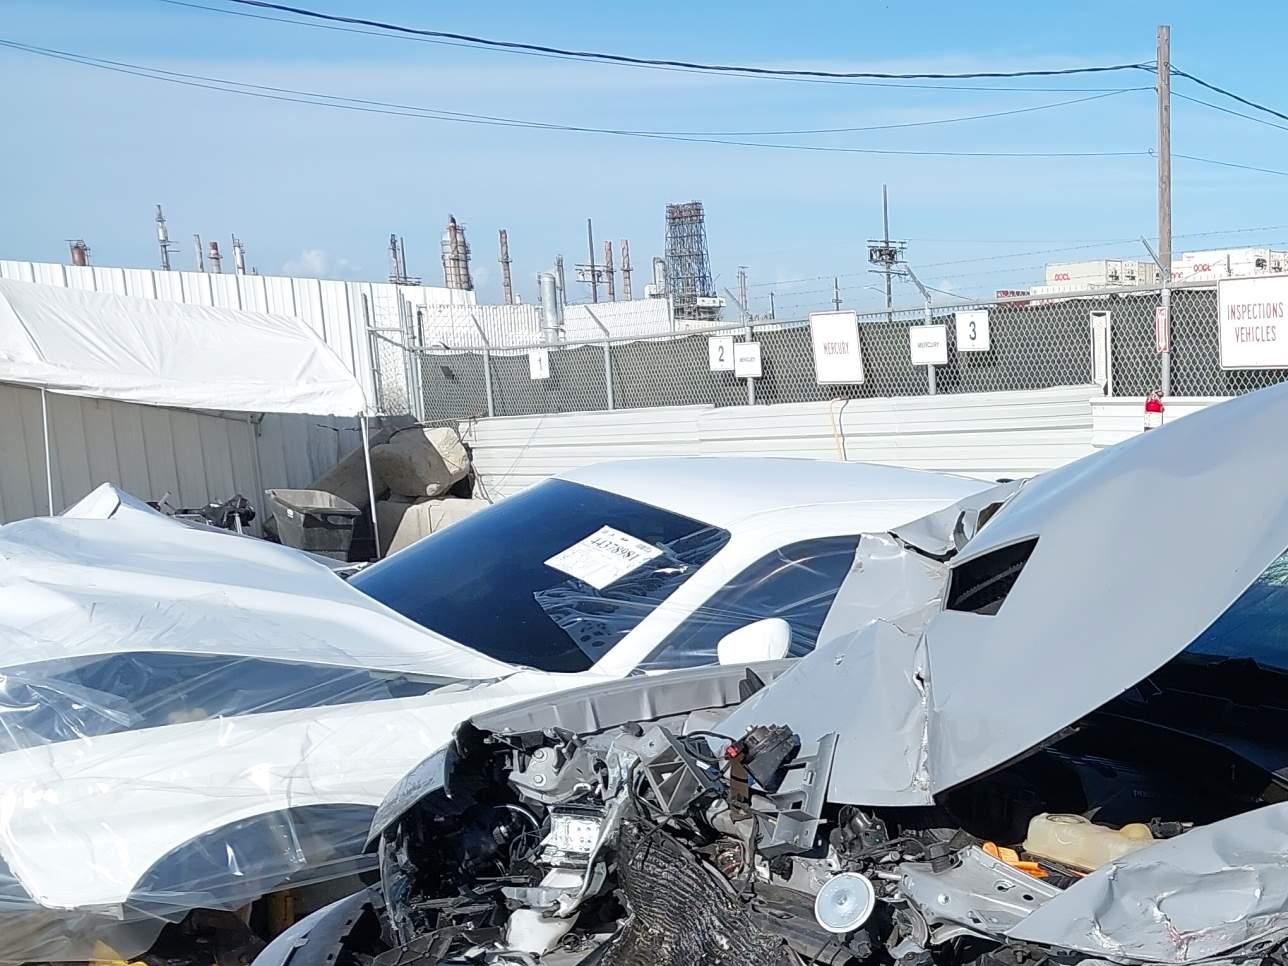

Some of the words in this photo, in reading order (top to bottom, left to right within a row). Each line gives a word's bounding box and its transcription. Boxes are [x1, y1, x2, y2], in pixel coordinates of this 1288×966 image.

[1227, 301, 1284, 321] INSPECTIONS
[968, 320, 977, 341] 3
[1235, 325, 1277, 343] VEHICLES
[718, 345, 725, 363] 2
